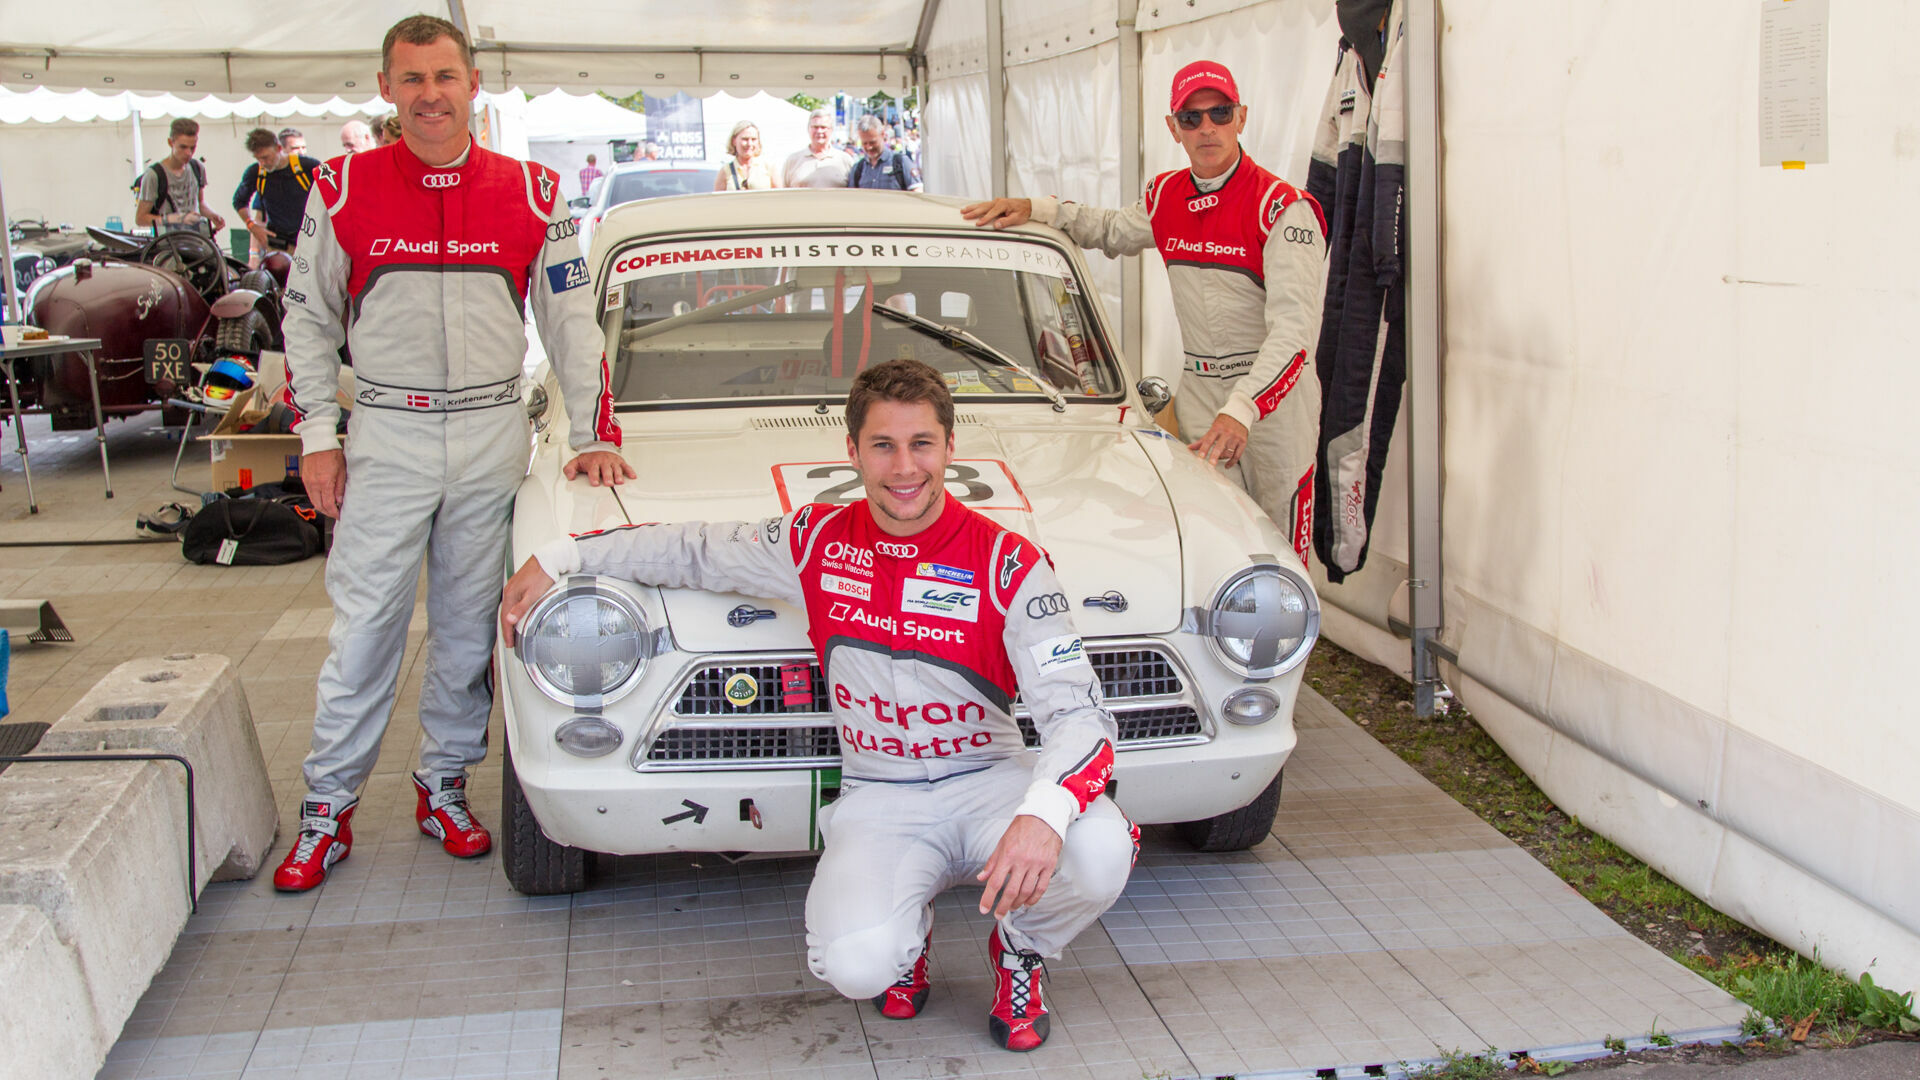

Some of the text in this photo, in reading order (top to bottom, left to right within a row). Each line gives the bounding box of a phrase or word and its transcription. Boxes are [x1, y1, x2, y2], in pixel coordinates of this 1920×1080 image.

[1186, 71, 1227, 83] Audi Sport
[671, 131, 703, 144] ROSS
[656, 145, 704, 159] RACING
[393, 238, 499, 257] Audi Sport
[1177, 239, 1246, 257] Audi Sport
[615, 244, 1064, 273] COPENHAGEN HISTORIC GRAND PRIX
[564, 259, 588, 281] 24h
[566, 280, 575, 289] LE
[154, 343, 181, 361] 50
[152, 362, 185, 380] FXE
[1219, 360, 1254, 371] Capello
[433, 393, 493, 406] T. Kristensen
[1347, 493, 1358, 528] 207
[1300, 499, 1311, 563] Sport
[824, 541, 874, 568] ORIS
[821, 558, 874, 578] Swiss Watches
[937, 568, 973, 580] MICHELIN
[837, 581, 869, 597] BOSCH
[921, 589, 977, 607] WEC
[849, 608, 965, 644] Audi Sport
[834, 683, 986, 731] e-tron
[842, 724, 993, 760] quattro
